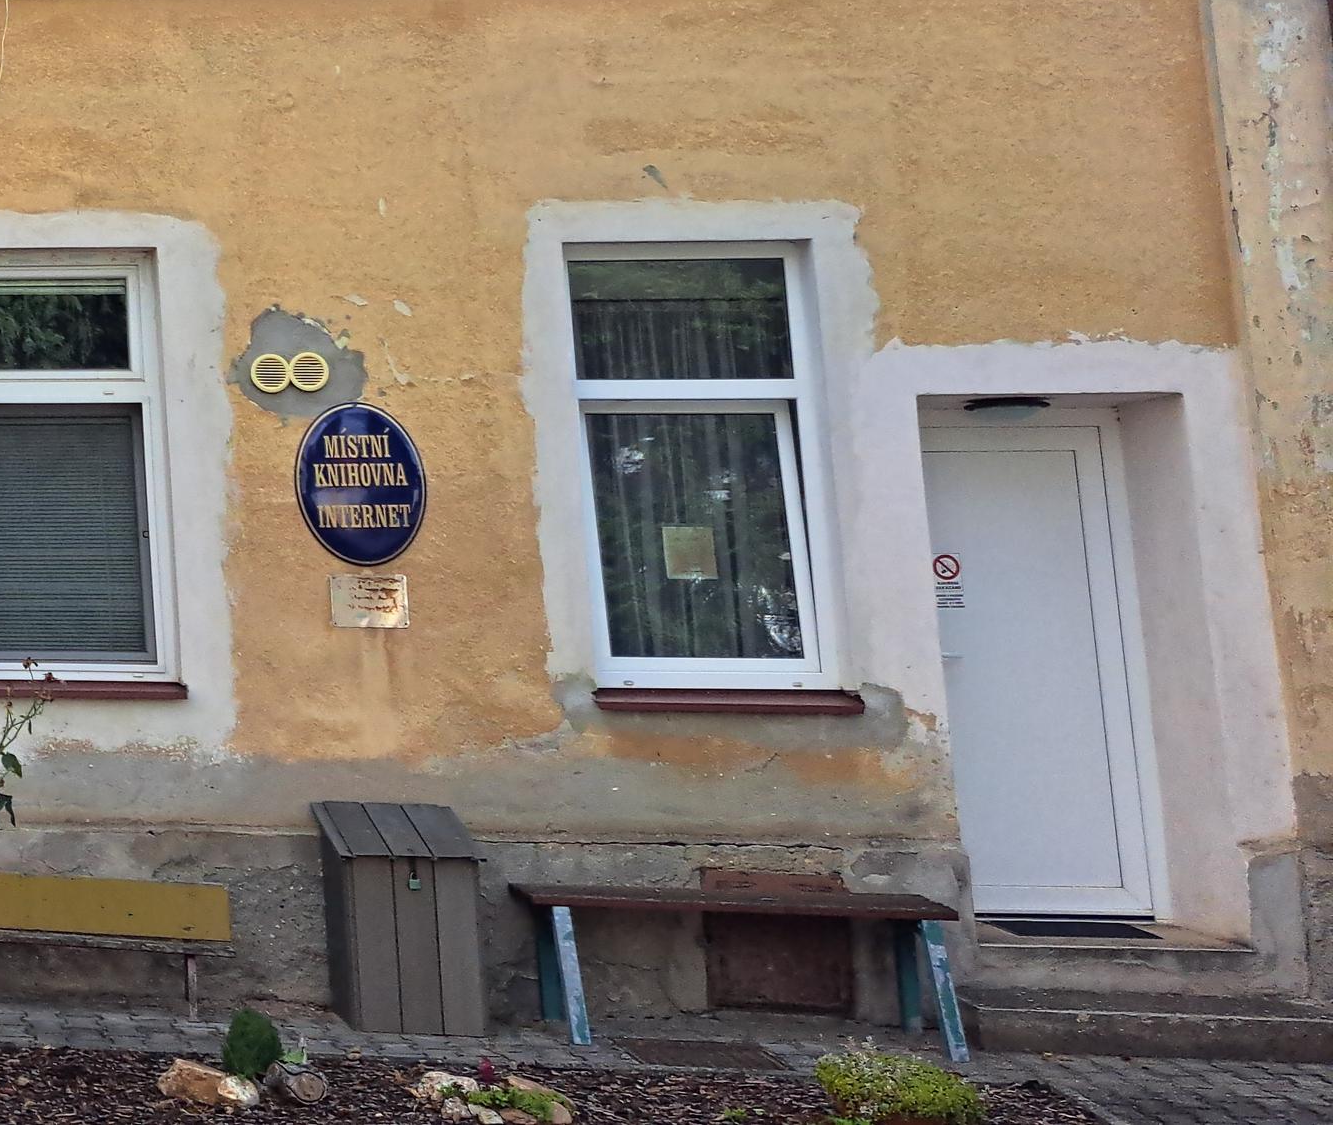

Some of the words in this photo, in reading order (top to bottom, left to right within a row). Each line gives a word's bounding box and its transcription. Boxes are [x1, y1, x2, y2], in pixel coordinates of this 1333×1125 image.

[323, 427, 391, 458] MÍSTNÍ
[313, 463, 409, 487] KNIHOVNA
[317, 504, 410, 529] INTERNET
